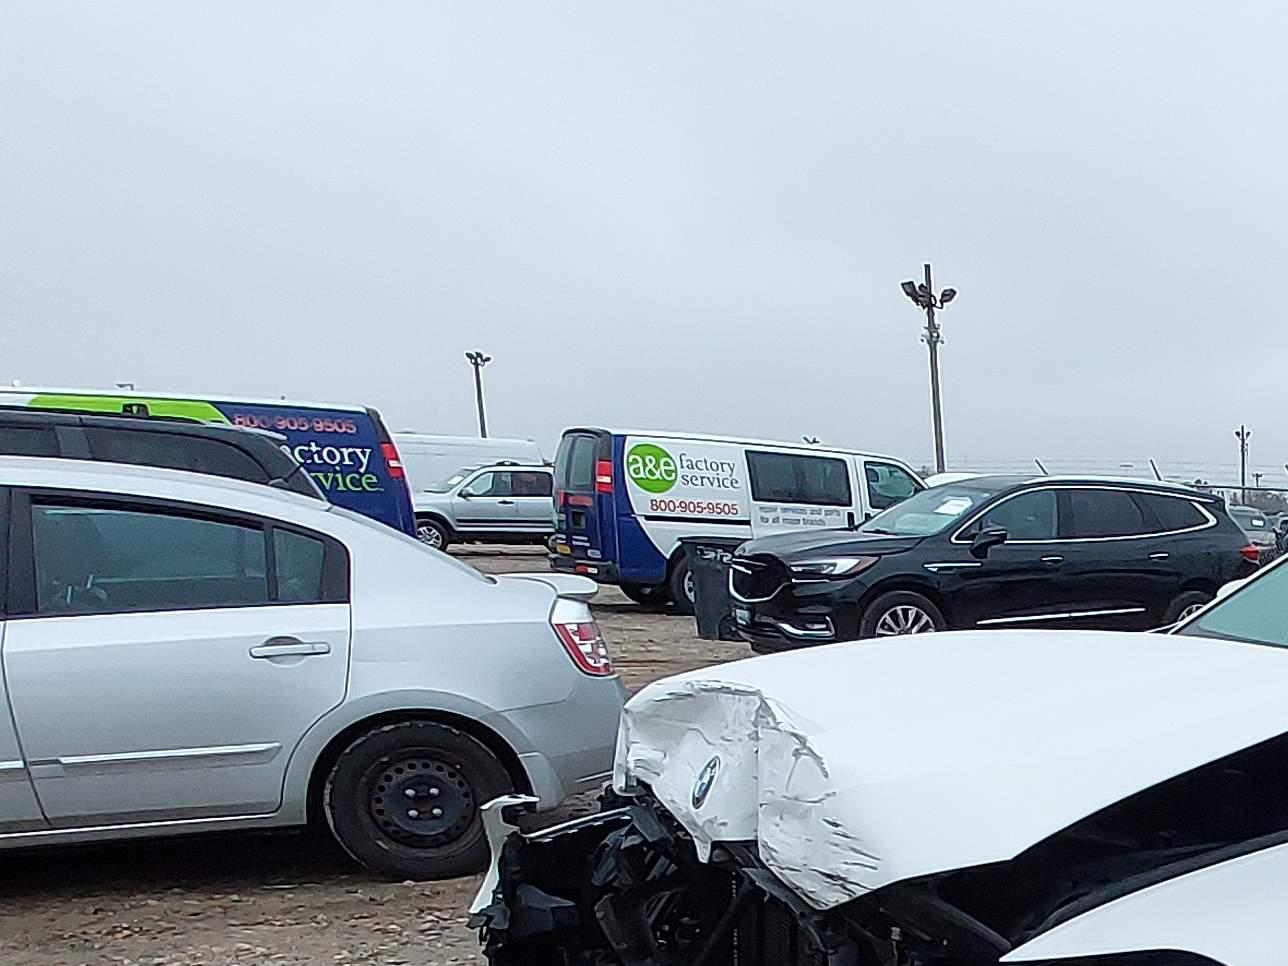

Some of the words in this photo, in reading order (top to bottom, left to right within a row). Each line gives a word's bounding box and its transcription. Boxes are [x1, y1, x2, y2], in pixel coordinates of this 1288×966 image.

[629, 454, 676, 481] a&e
[679, 453, 736, 478] factory
[311, 466, 384, 491] vice
[681, 473, 741, 489] service
